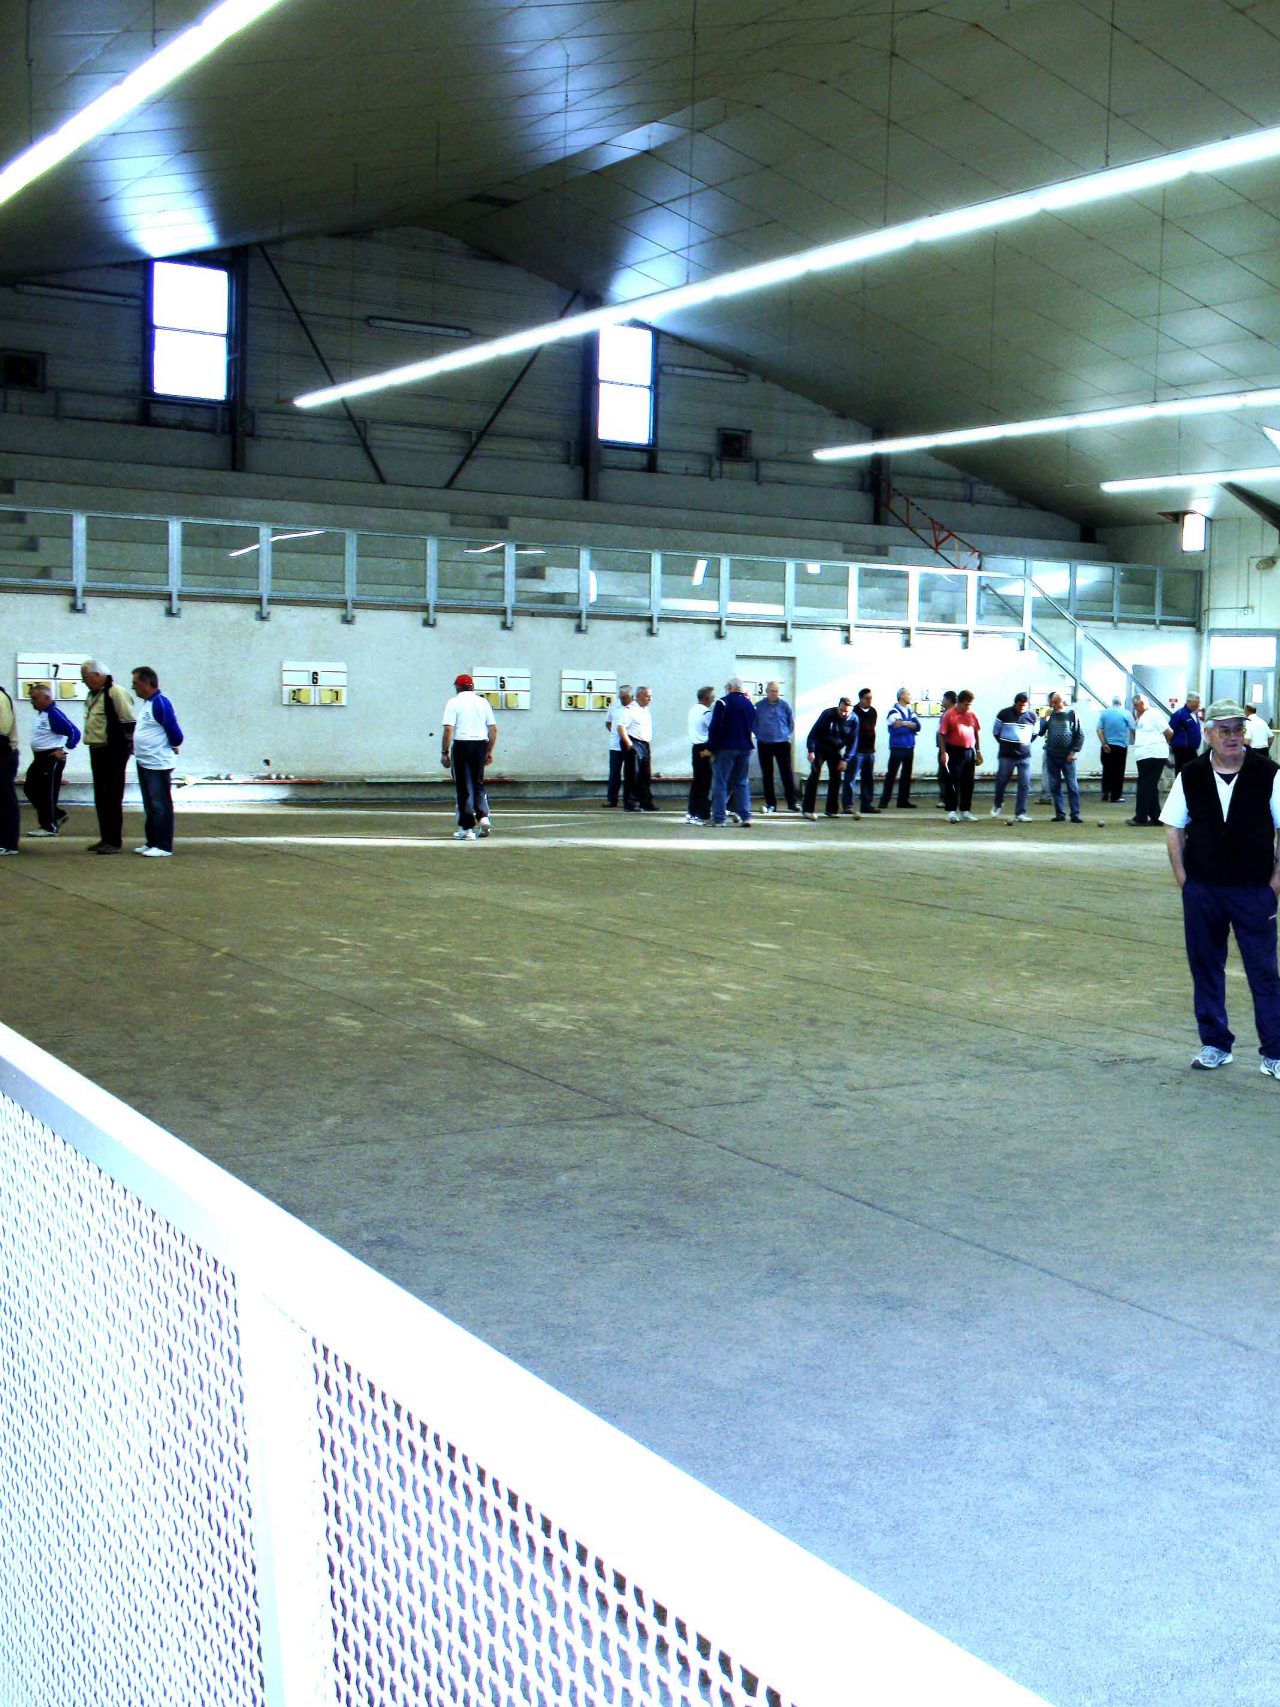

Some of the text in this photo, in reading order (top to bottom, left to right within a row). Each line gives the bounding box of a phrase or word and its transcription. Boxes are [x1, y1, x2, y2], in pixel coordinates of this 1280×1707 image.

[52, 664, 59, 677] 7
[312, 672, 319, 684] 6
[500, 677, 505, 689] 5
[586, 681, 592, 692] 4
[758, 683, 763, 694] 3
[291, 690, 297, 701] 2
[568, 696, 573, 706] 3
